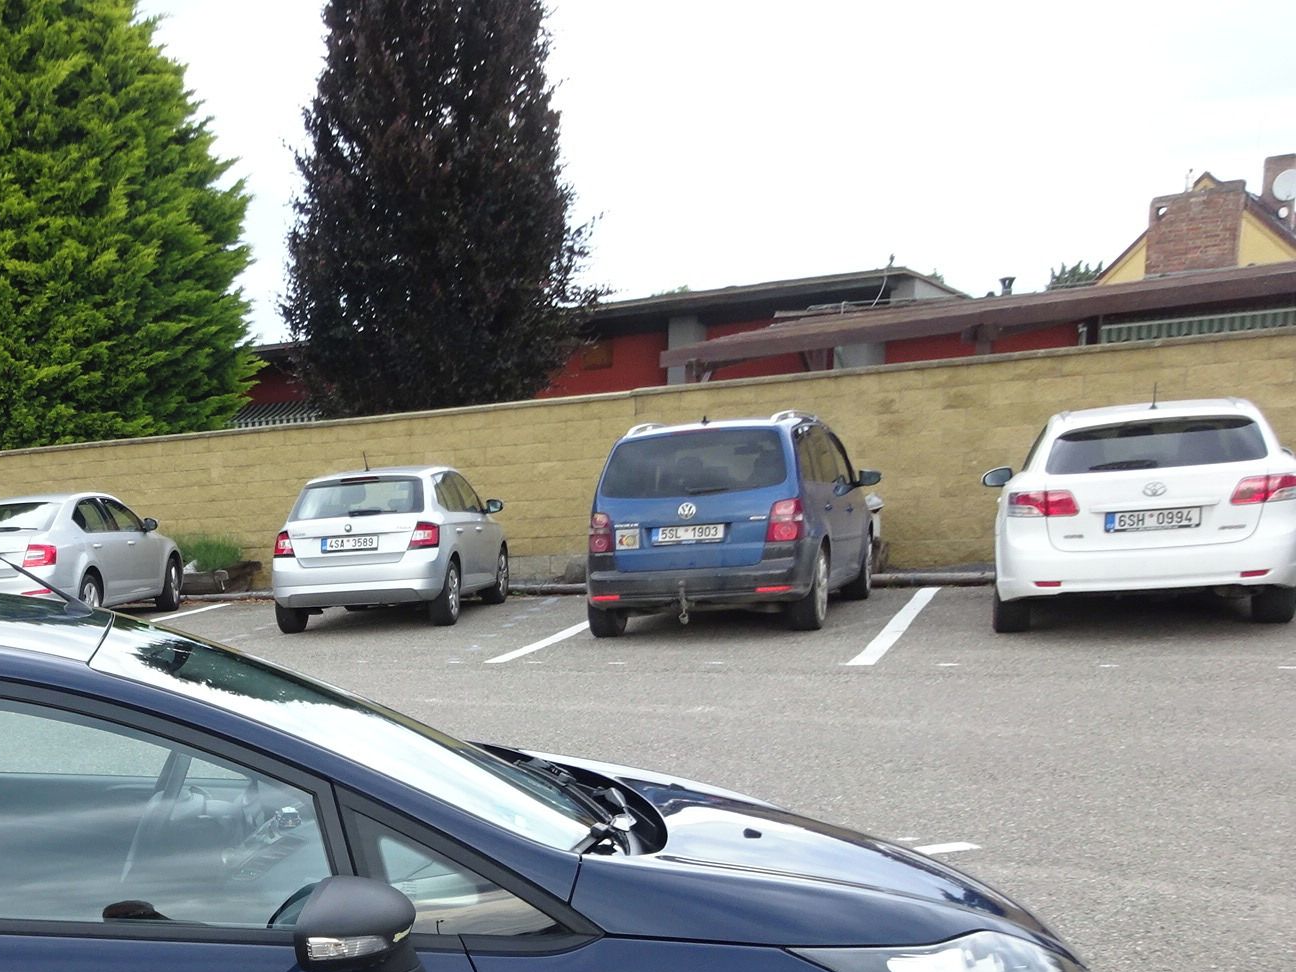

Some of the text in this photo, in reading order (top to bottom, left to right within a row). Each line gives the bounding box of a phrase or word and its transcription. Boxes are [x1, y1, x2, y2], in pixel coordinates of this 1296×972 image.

[1118, 510, 1193, 527] 6SH 0994
[660, 526, 719, 540] 5SL 1903
[328, 537, 374, 548] 4SA 3589
